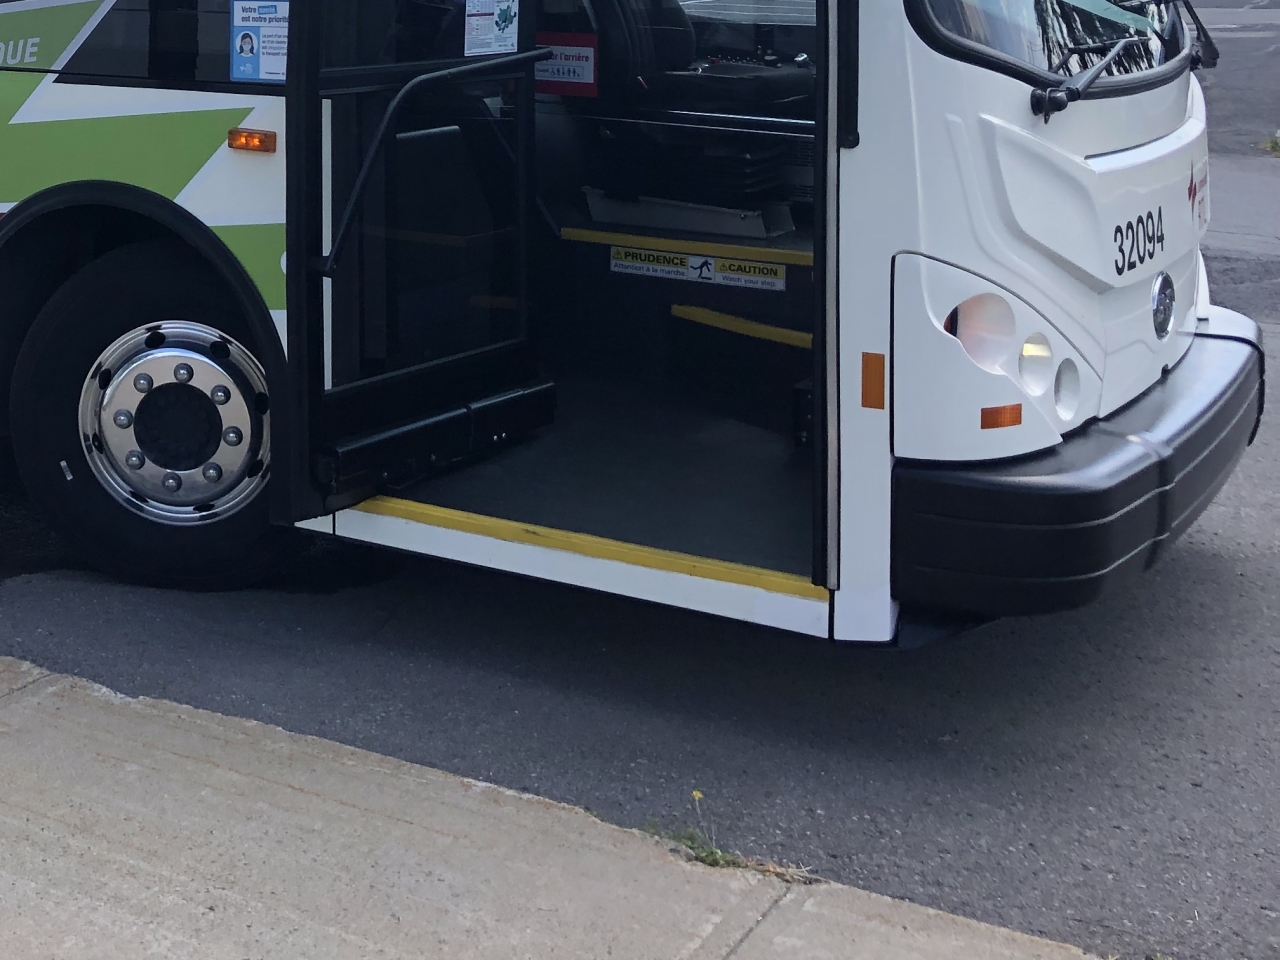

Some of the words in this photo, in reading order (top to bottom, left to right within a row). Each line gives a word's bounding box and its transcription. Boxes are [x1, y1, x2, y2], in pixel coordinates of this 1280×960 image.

[1114, 206, 1165, 276] 32094
[624, 251, 687, 267] PRUDENCE
[613, 262, 645, 273] Attention
[728, 263, 778, 277] CAUTION
[722, 274, 742, 284] Watch
[744, 279, 759, 287] your
